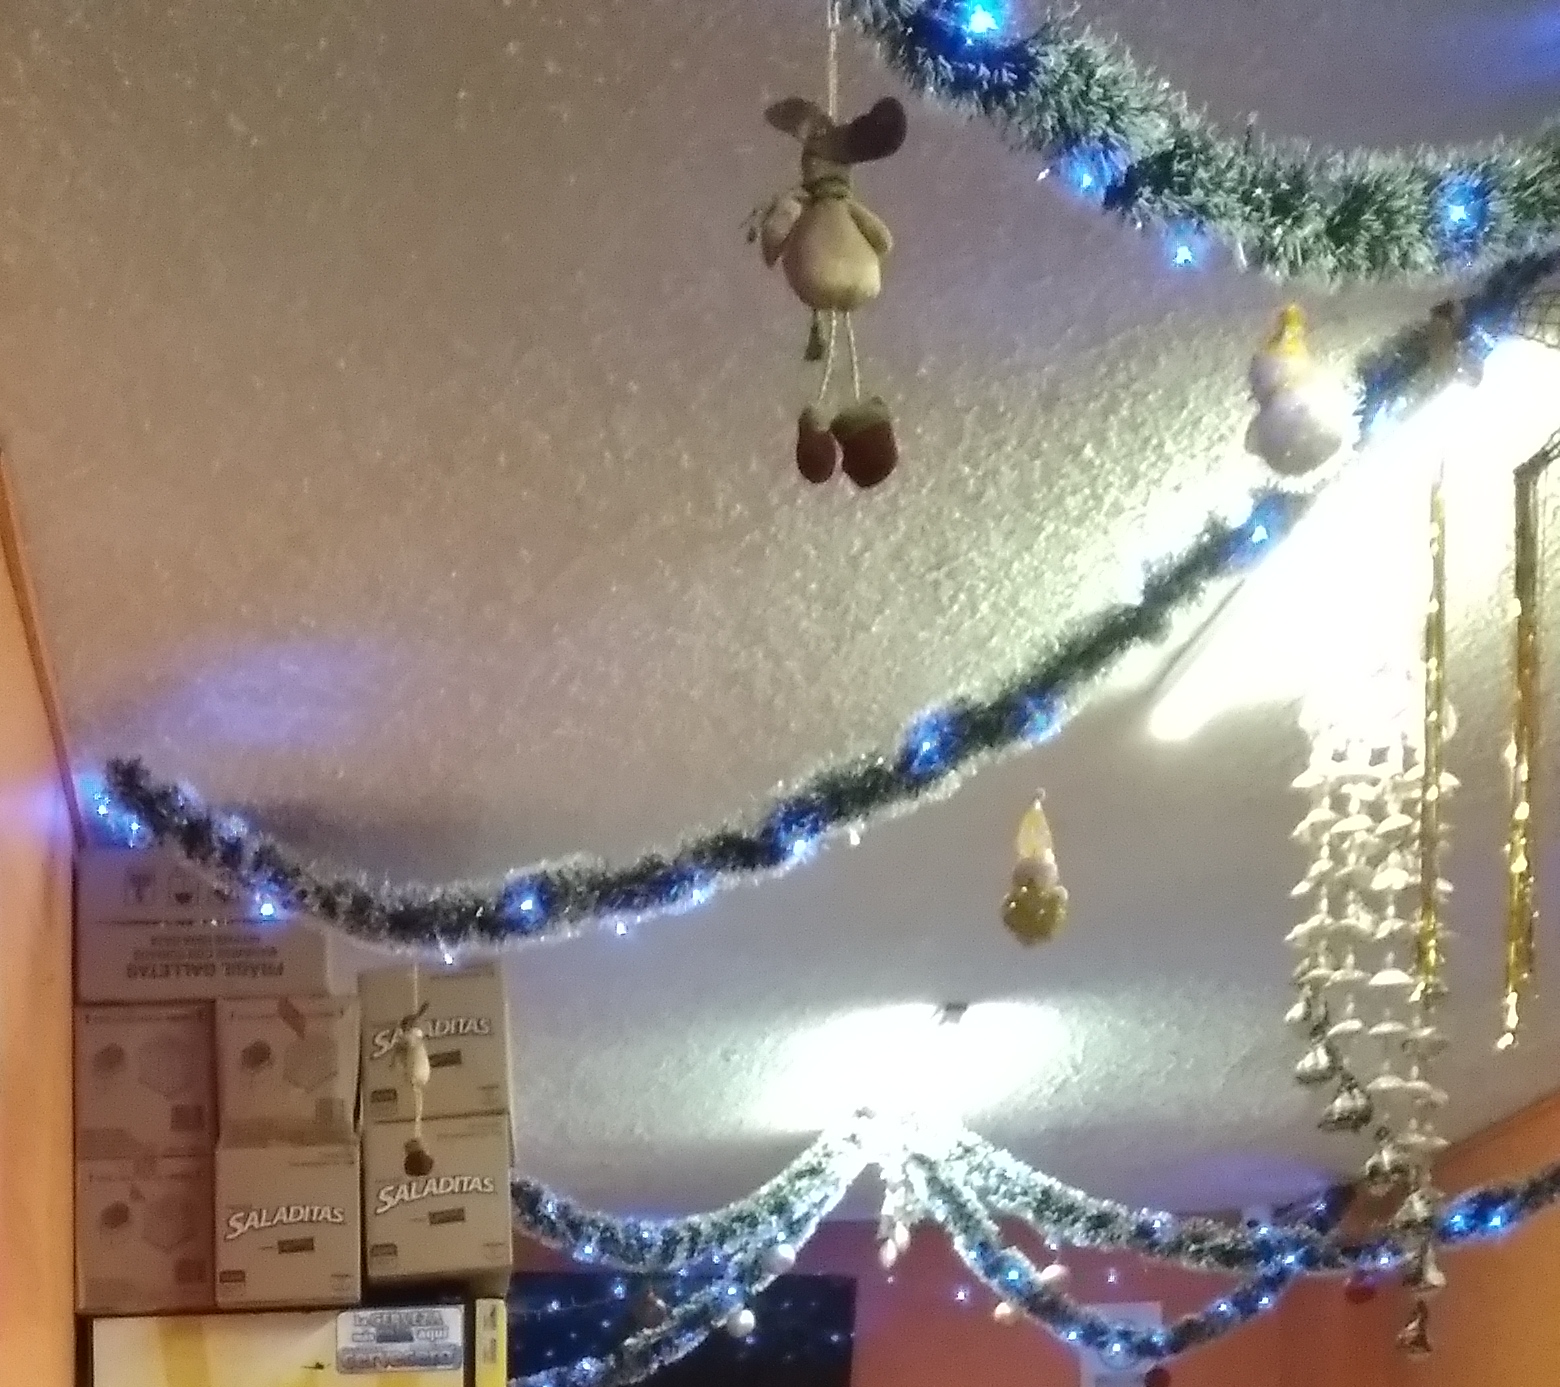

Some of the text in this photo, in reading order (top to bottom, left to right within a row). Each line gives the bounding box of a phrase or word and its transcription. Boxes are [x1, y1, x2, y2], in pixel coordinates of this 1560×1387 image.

[370, 1015, 492, 1060] SAADITAS
[375, 1175, 496, 1215] SALADITAS
[224, 1204, 346, 1241] SALADITAS
